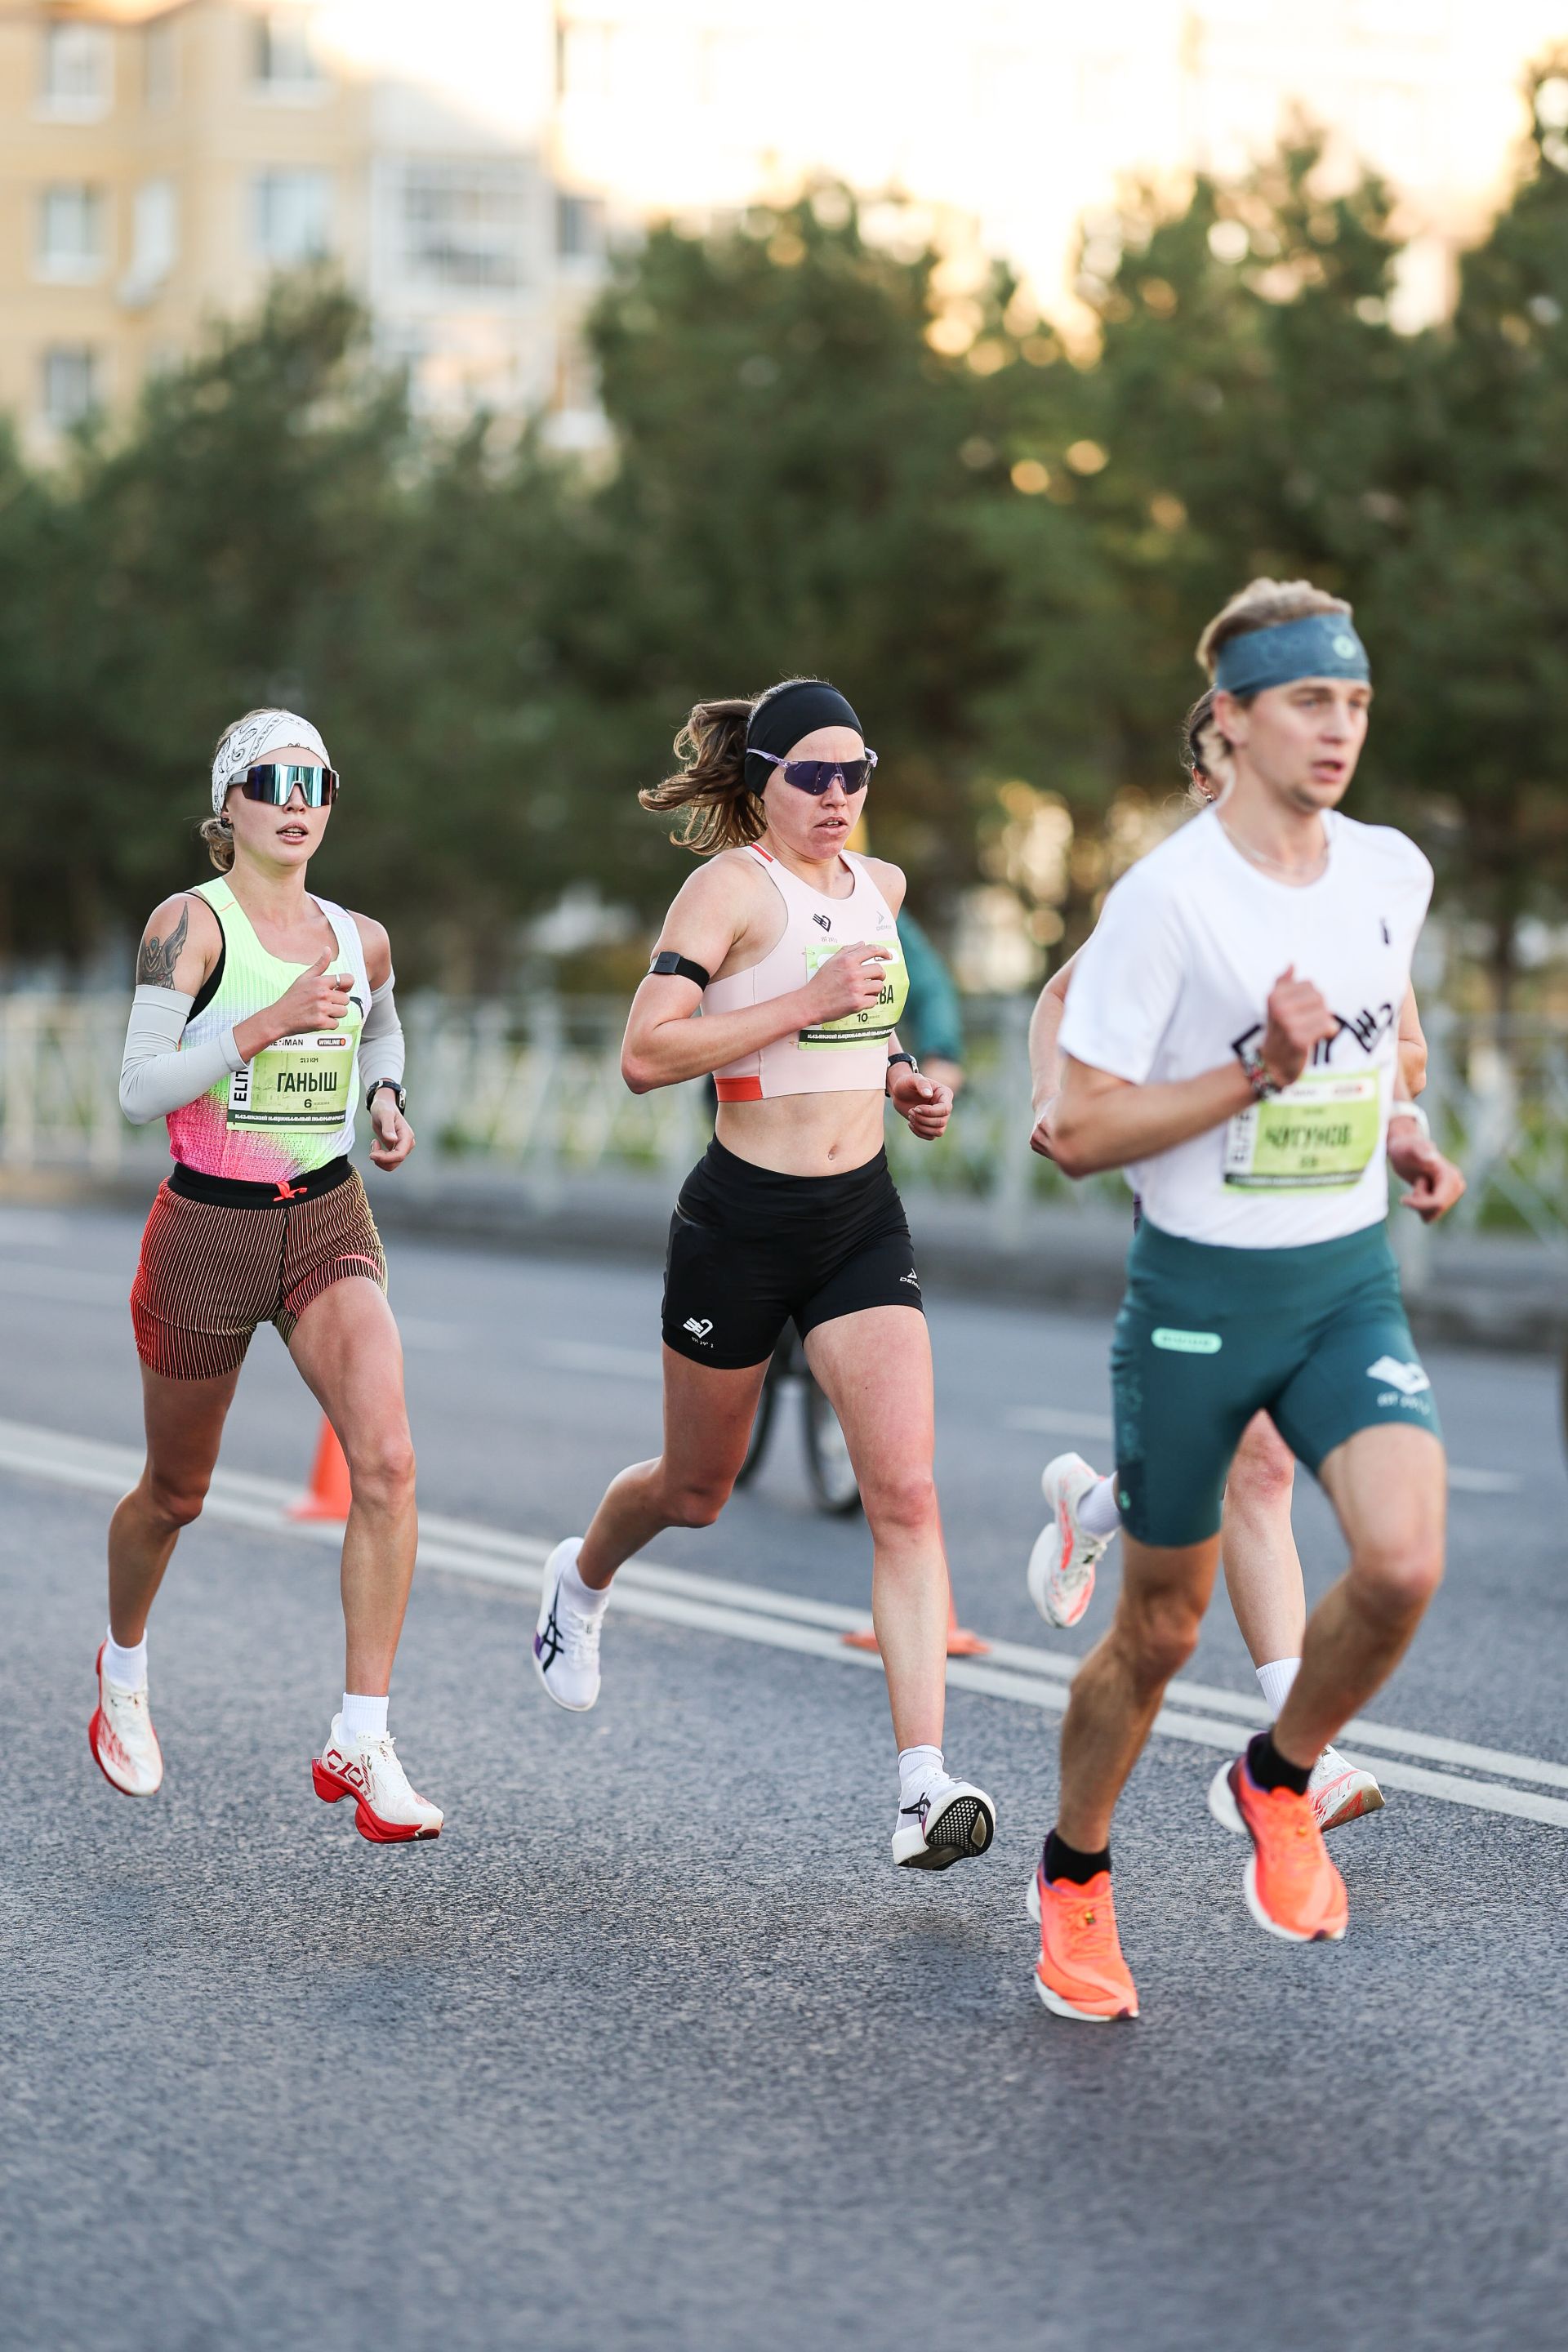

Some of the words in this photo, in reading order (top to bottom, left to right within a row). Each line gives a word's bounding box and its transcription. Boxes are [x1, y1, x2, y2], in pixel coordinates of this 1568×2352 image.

[875, 985, 893, 1004] ВА
[857, 1013, 868, 1022] 10
[234, 1071, 249, 1102] ELIT
[277, 1071, 337, 1093] ГАНЫШ
[304, 1098, 312, 1108] 6
